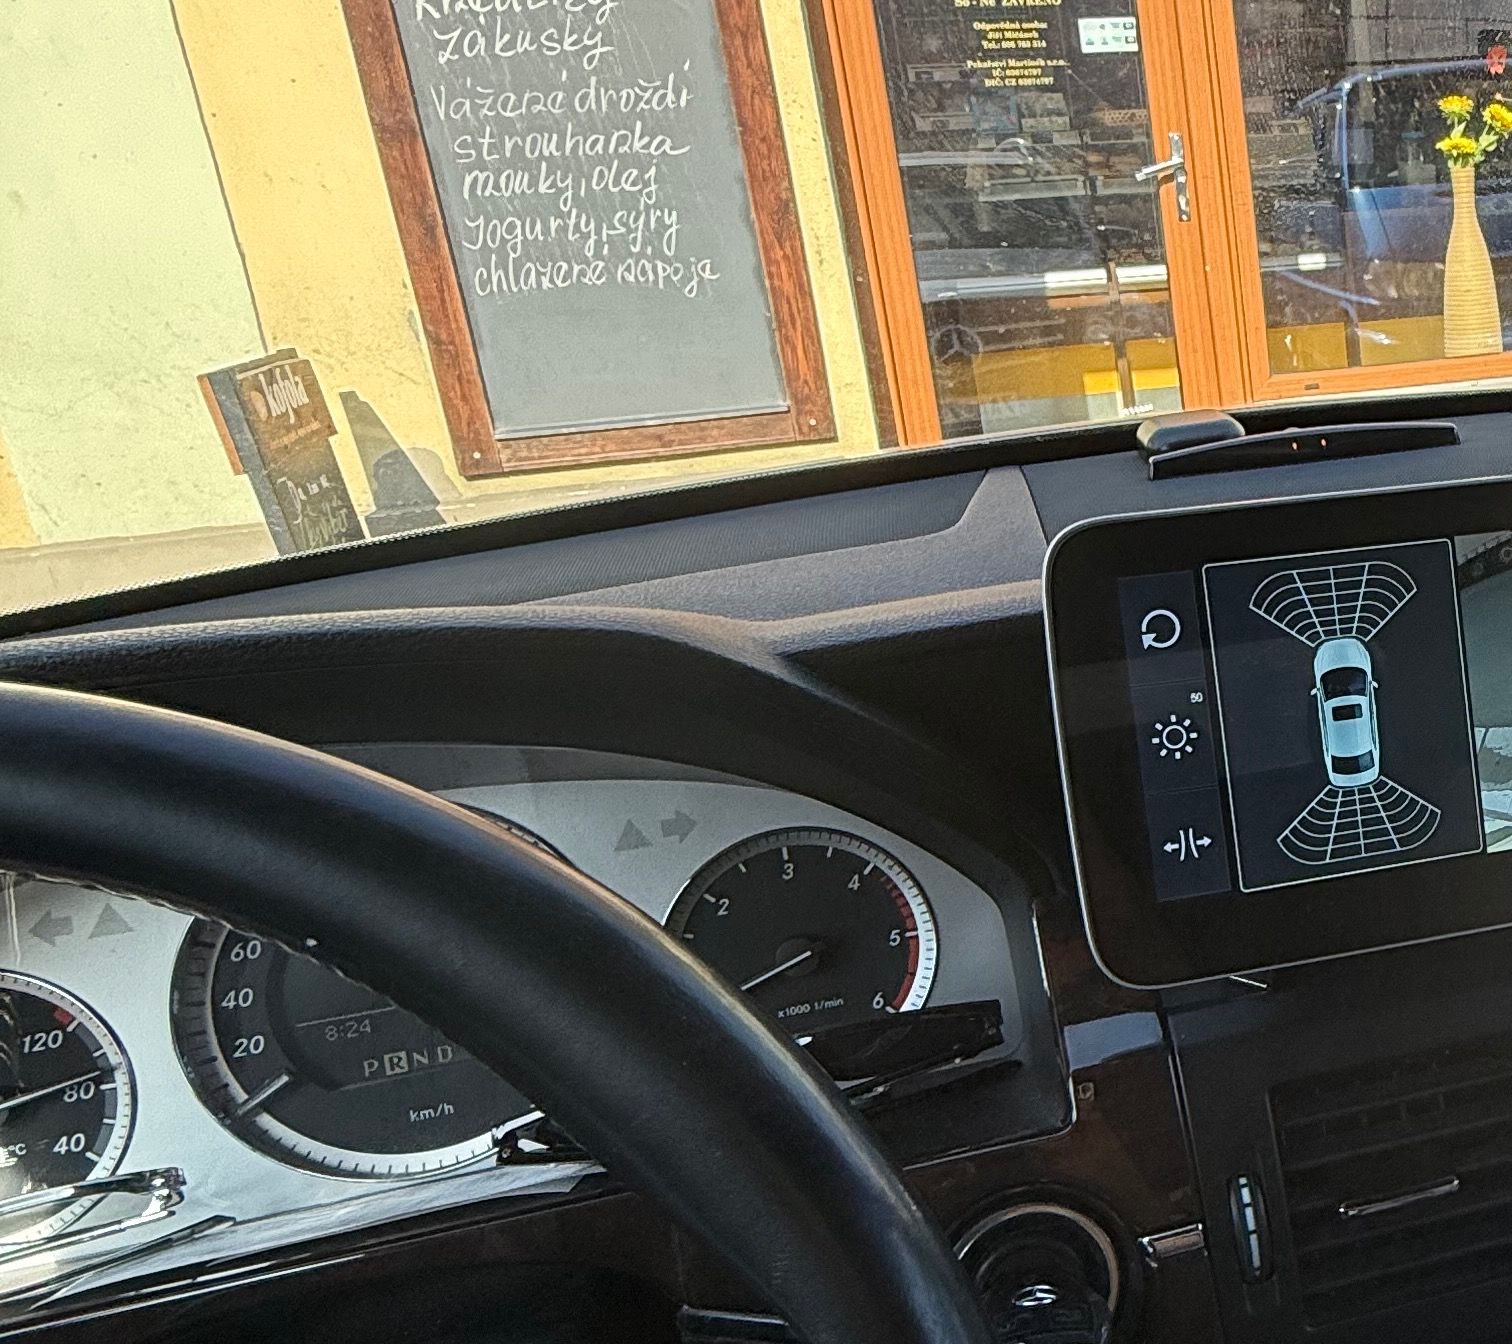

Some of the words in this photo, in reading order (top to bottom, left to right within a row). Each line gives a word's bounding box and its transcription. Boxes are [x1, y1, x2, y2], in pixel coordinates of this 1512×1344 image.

[782, 863, 794, 881] 3
[848, 874, 861, 891] 4
[717, 898, 730, 916] 2
[888, 929, 902, 947] 5
[230, 940, 262, 962] 60
[221, 988, 254, 1009] 40
[873, 992, 885, 1010] 6
[778, 1003, 811, 1018] x1000
[324, 1018, 371, 1041] 8:24
[22, 1029, 63, 1054] 120
[232, 1035, 265, 1058] 20
[363, 1059, 379, 1077] P
[413, 1050, 429, 1067] N
[437, 1045, 453, 1063] D
[63, 1081, 95, 1103] 80
[409, 1102, 454, 1123] km/h
[53, 1133, 86, 1155] 40
